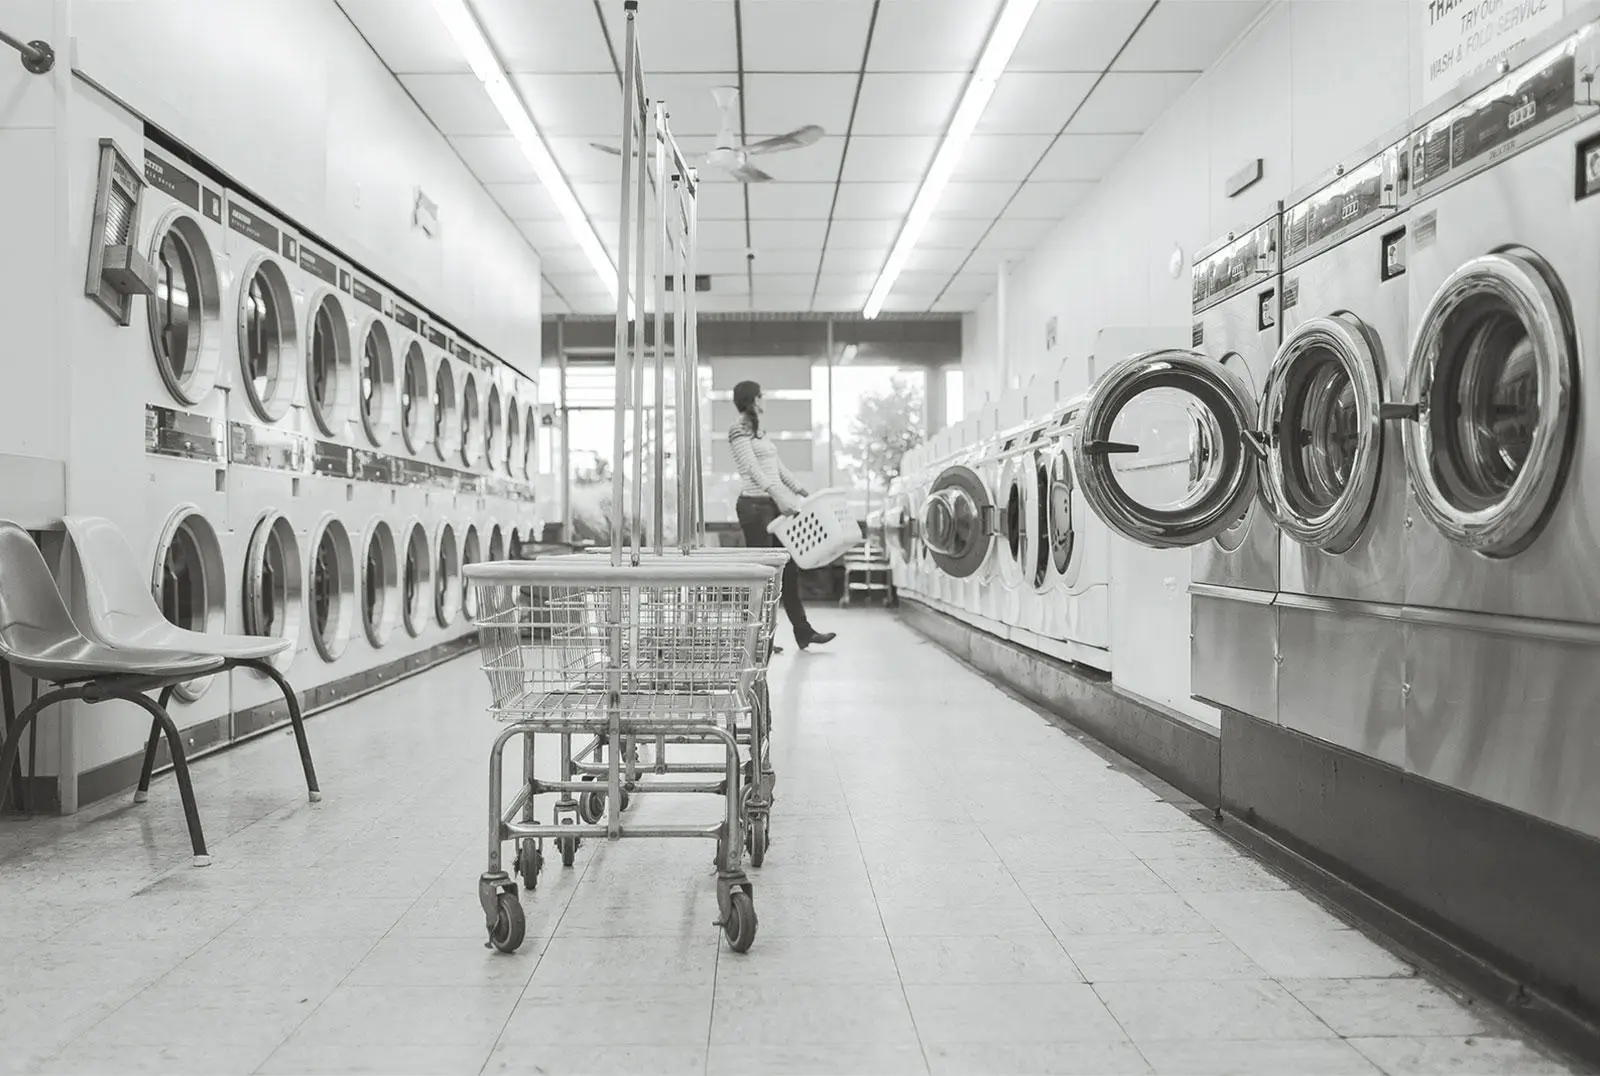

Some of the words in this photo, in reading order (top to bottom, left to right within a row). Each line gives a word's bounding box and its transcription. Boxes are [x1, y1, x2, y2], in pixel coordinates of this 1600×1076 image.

[1461, 5, 1480, 34] TRY
[1430, 47, 1455, 80] WASH
[1455, 43, 1463, 63] &
[1466, 22, 1493, 56] FOLD
